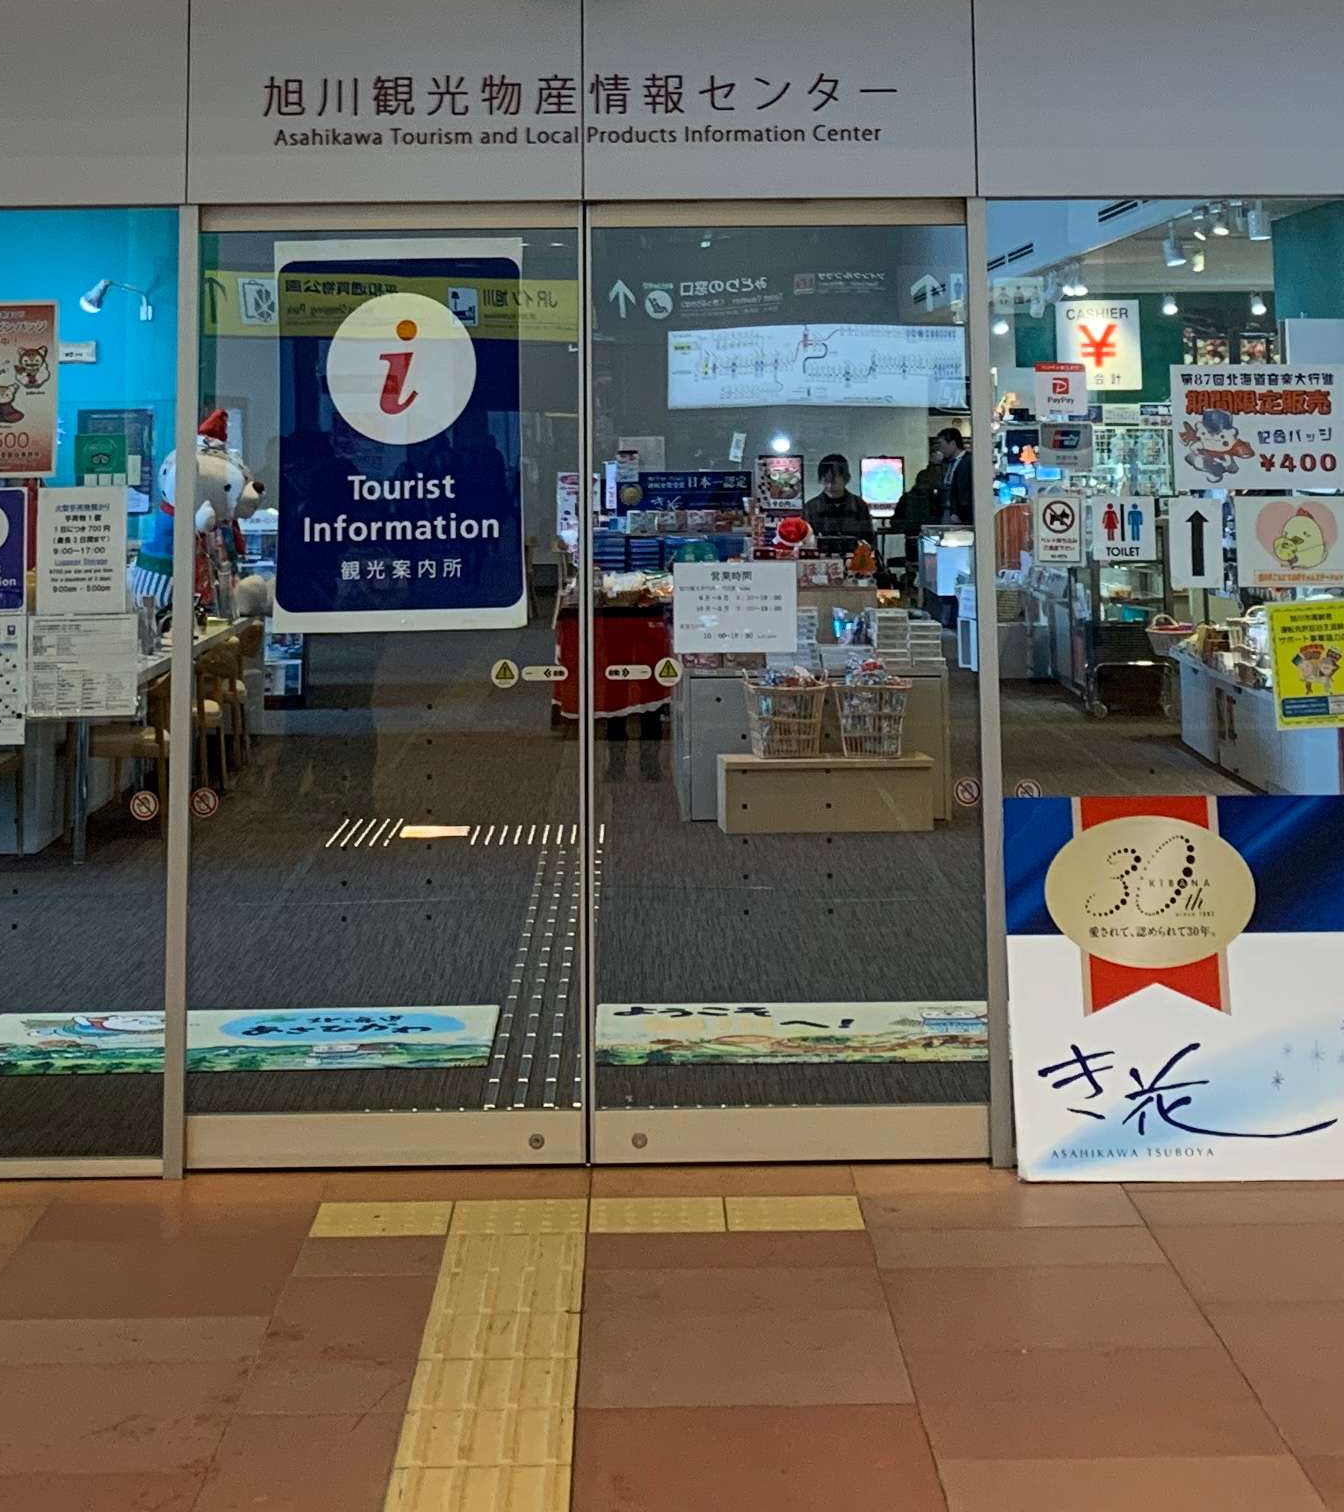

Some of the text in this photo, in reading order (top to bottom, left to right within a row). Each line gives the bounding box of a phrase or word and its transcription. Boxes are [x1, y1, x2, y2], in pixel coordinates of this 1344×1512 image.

[262, 73, 899, 118] 旭川観光物産情報センター
[274, 123, 882, 146] Asahikawa Tourism and Local Products Information Center
[1065, 307, 1129, 320] CASHIER
[1047, 396, 1075, 405] PayPay
[1185, 389, 1333, 416] 期間限定販売
[1259, 452, 1337, 473] ¥400
[347, 472, 456, 502] Tourist
[302, 513, 500, 543] Information
[1105, 546, 1141, 557] TOILET
[340, 557, 463, 581] 観光案内所
[710, 570, 753, 582] 営業時間
[1148, 878, 1211, 888] KIBANA
[613, 1005, 773, 1018] ようこそ
[1050, 1146, 1216, 1160] ASAHIKAWA TSUBOYA
